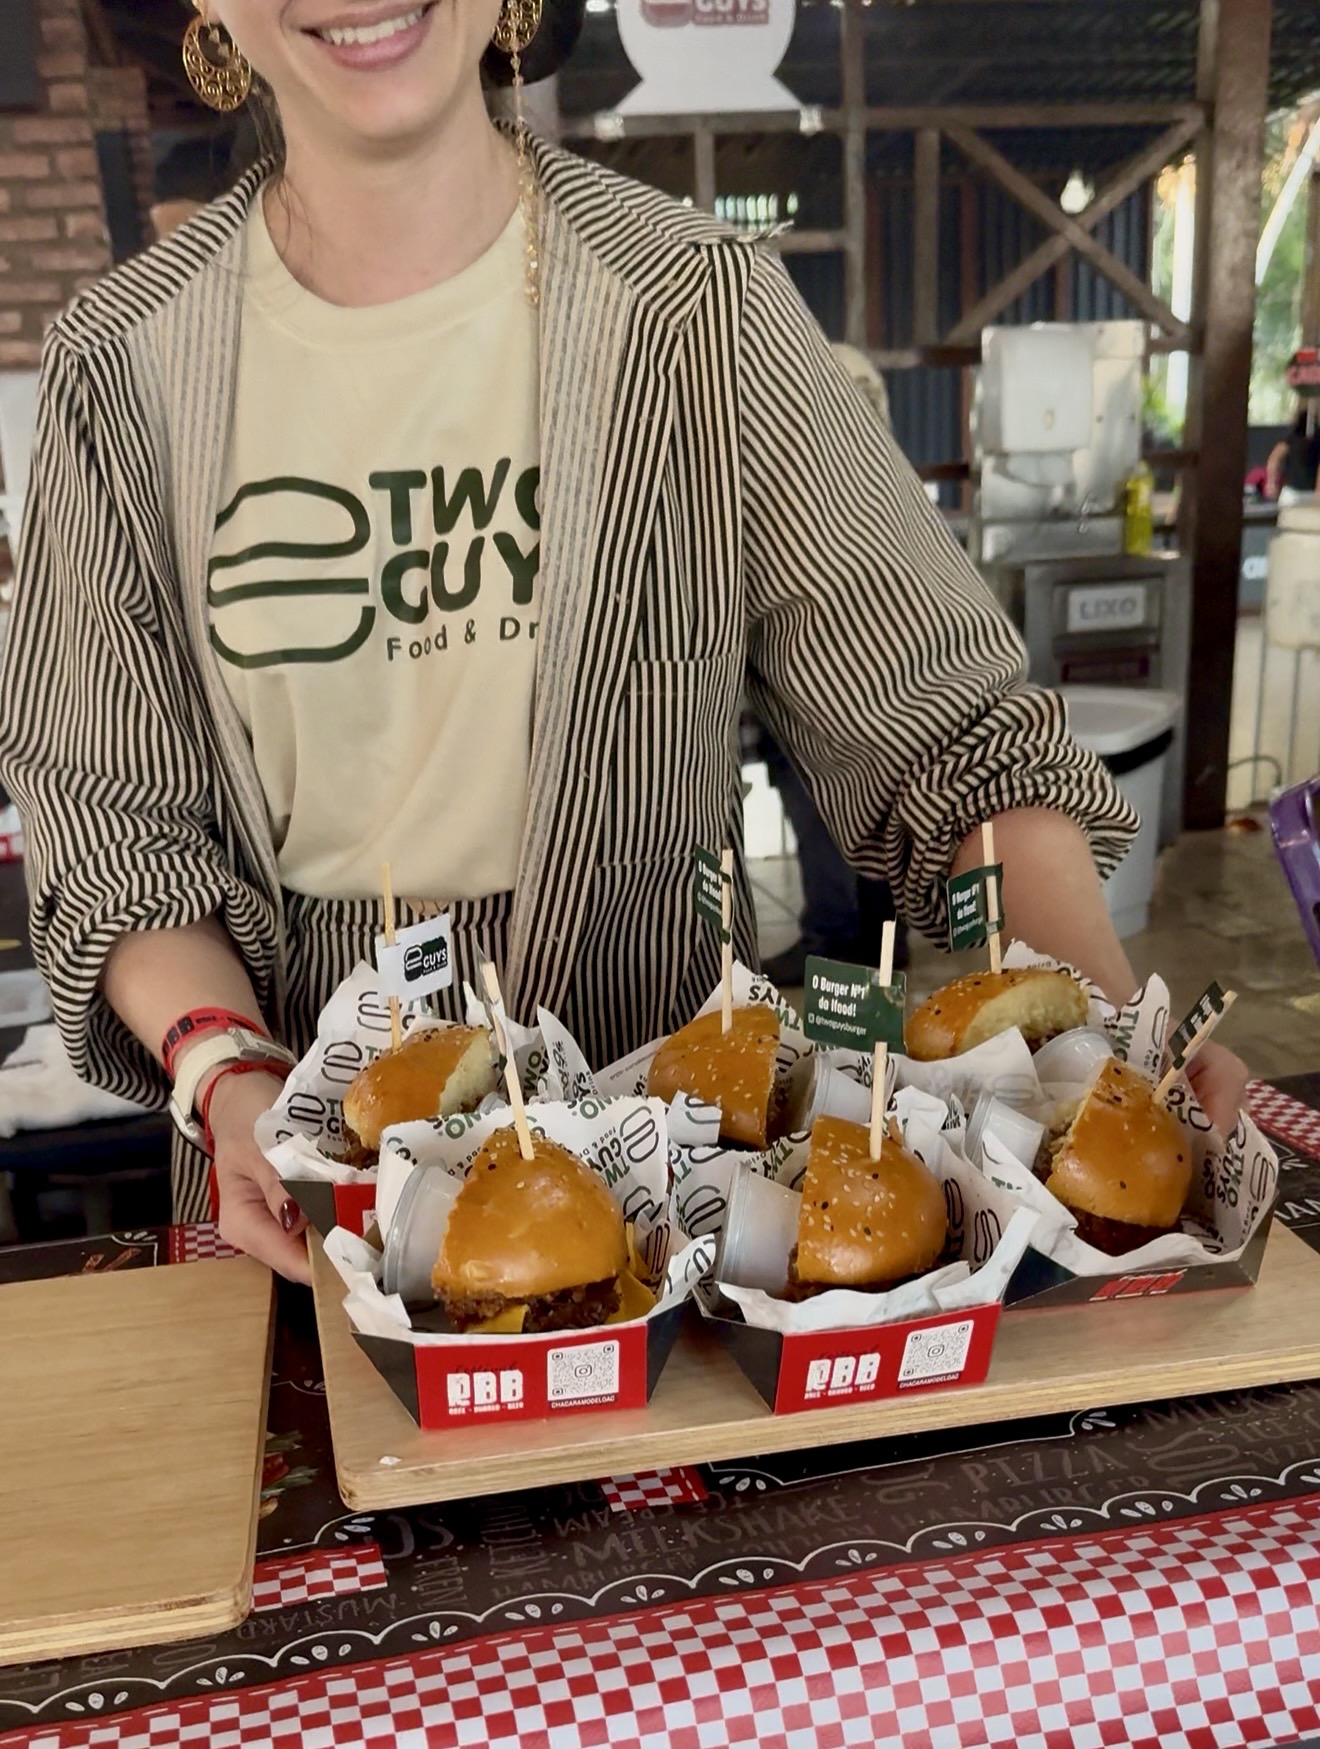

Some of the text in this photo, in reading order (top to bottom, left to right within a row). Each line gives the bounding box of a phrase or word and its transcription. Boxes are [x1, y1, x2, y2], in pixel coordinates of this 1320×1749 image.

[381, 532, 540, 624] GUY
[1079, 597, 1137, 621] LIXO
[387, 624, 448, 661] Food
[464, 619, 476, 644] &
[423, 948, 447, 968] GUYS
[812, 975, 819, 990] O
[820, 977, 849, 997] Burger
[830, 999, 857, 1018] Ifood!
[587, 1137, 622, 1173] GUY
[604, 1154, 631, 1189] TW
[957, 1445, 1128, 1494] PIZZA
[569, 1496, 862, 1567] MILKSHAKE
[235, 1592, 400, 1642] MUSTARD
